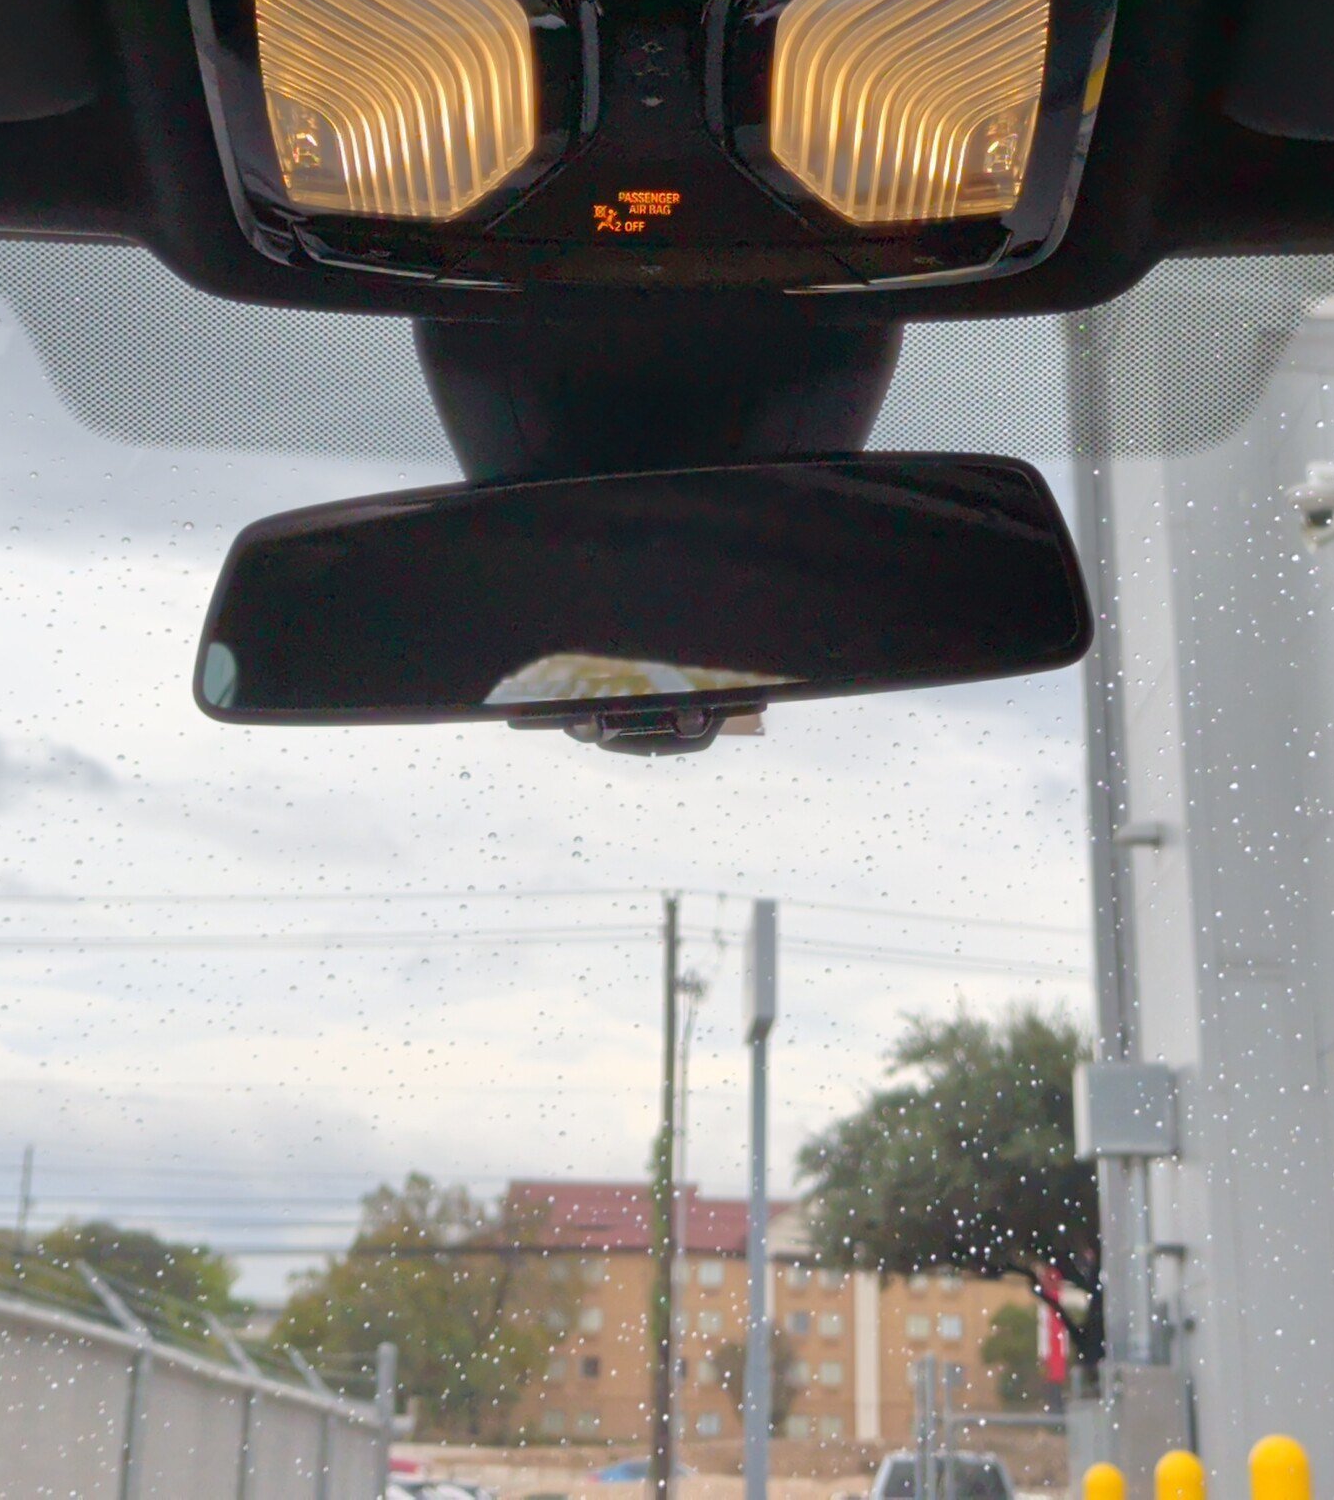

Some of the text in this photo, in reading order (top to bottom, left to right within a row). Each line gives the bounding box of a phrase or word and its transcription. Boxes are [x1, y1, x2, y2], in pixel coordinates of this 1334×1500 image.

[618, 191, 681, 204] PASSENGER
[628, 204, 671, 215] AIR BAG
[624, 221, 646, 232] OFF
